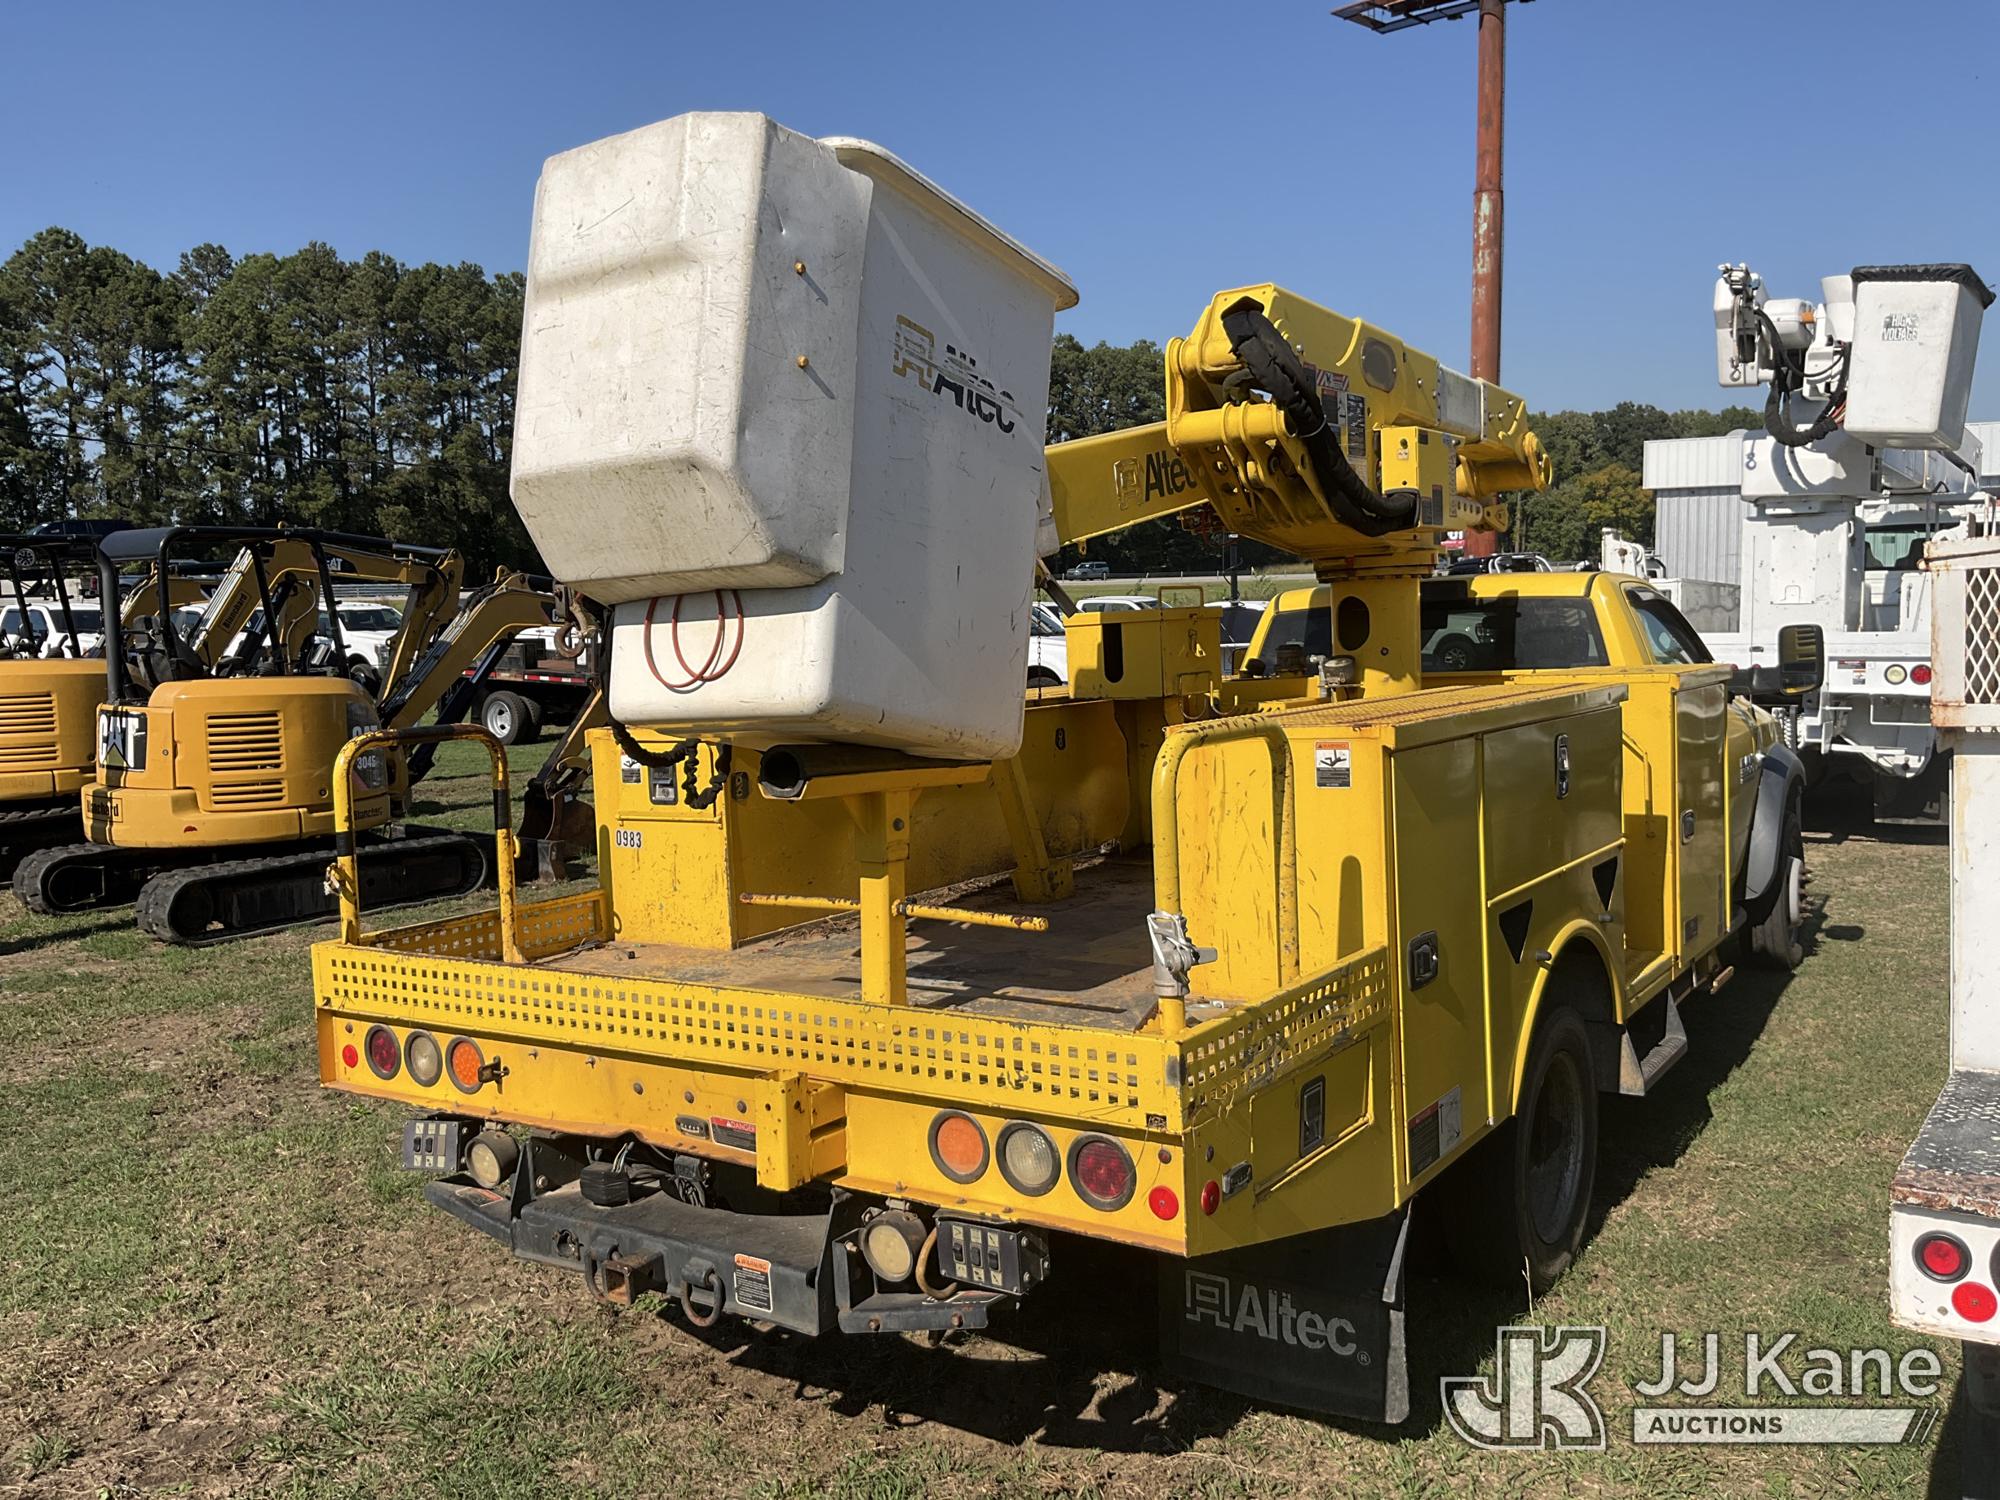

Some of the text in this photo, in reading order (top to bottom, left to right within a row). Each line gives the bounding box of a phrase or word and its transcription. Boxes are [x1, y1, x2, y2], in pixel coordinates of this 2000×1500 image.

[98, 713, 140, 768] CAT
[616, 830, 642, 848] 0983
[1233, 1284, 1357, 1356] Altec
